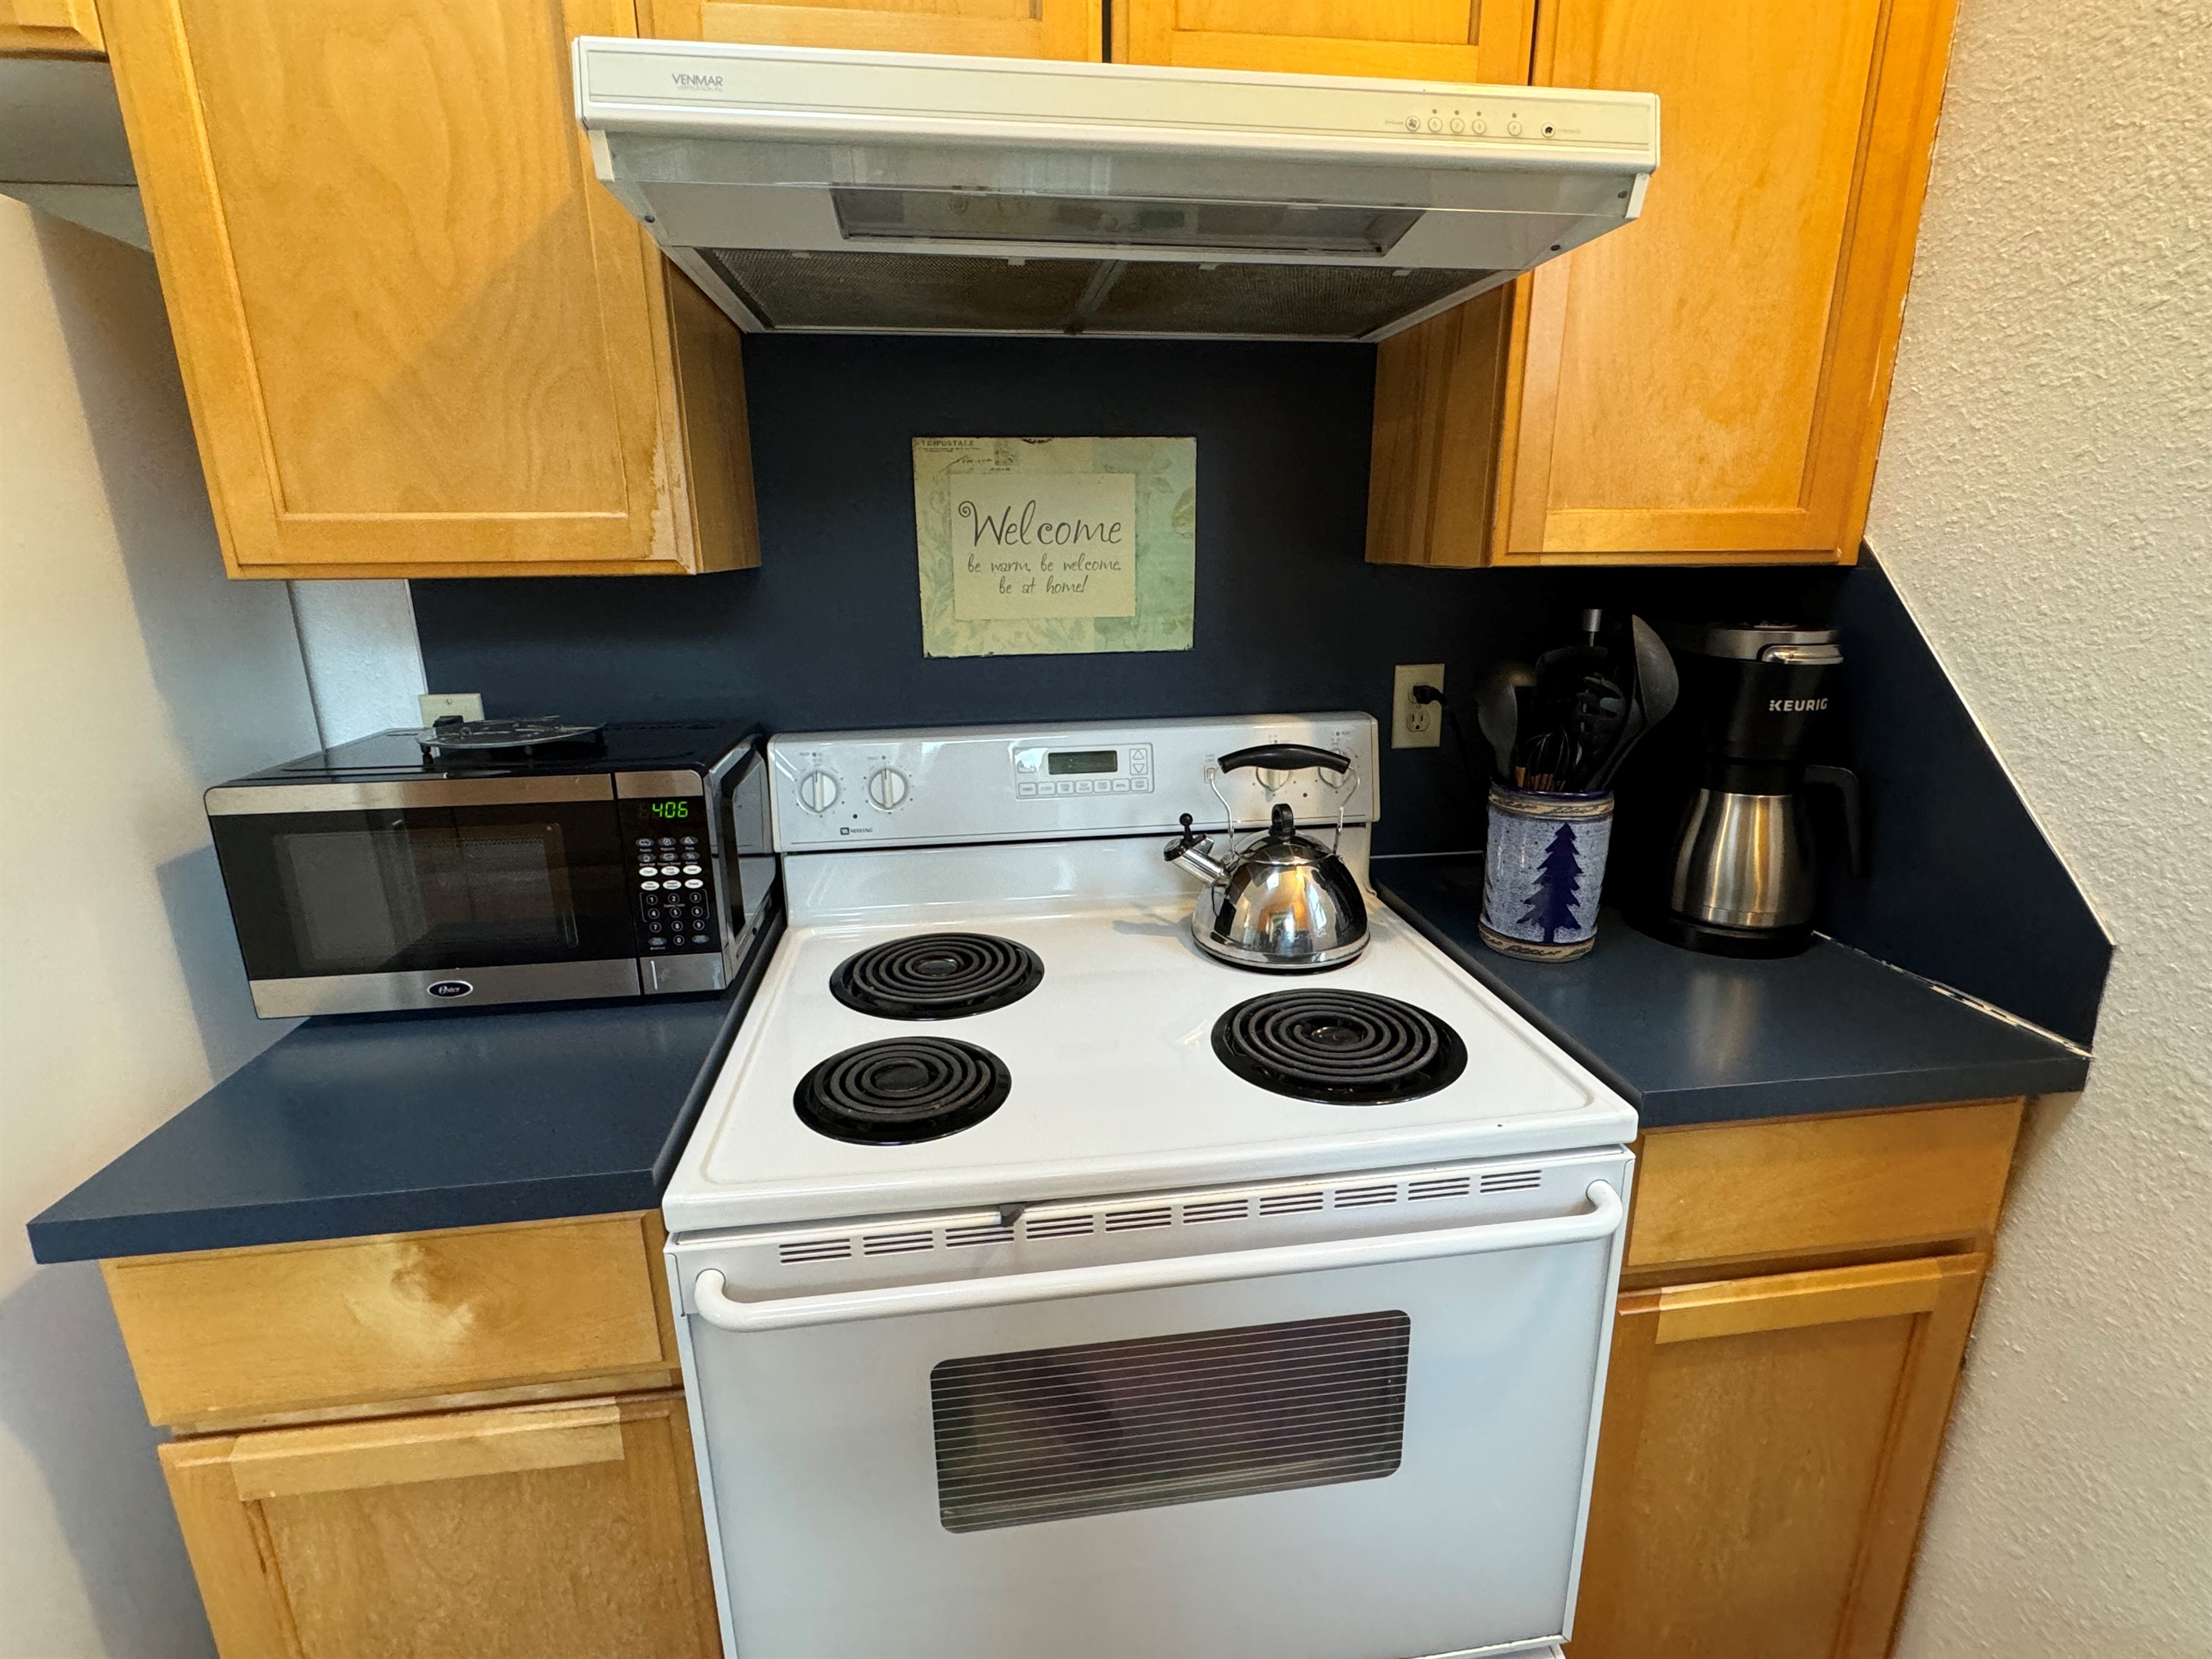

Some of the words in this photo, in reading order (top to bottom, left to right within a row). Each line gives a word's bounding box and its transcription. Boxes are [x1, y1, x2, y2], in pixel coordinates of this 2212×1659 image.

[671, 73, 724, 86] VENMAR
[958, 499, 1122, 547] Welcome
[967, 554, 981, 572] be
[1040, 553, 1054, 572] be
[999, 576, 1012, 594] be
[1022, 577, 1035, 594] at
[1046, 575, 1089, 594] home!
[1769, 698, 1828, 711] KEURIG
